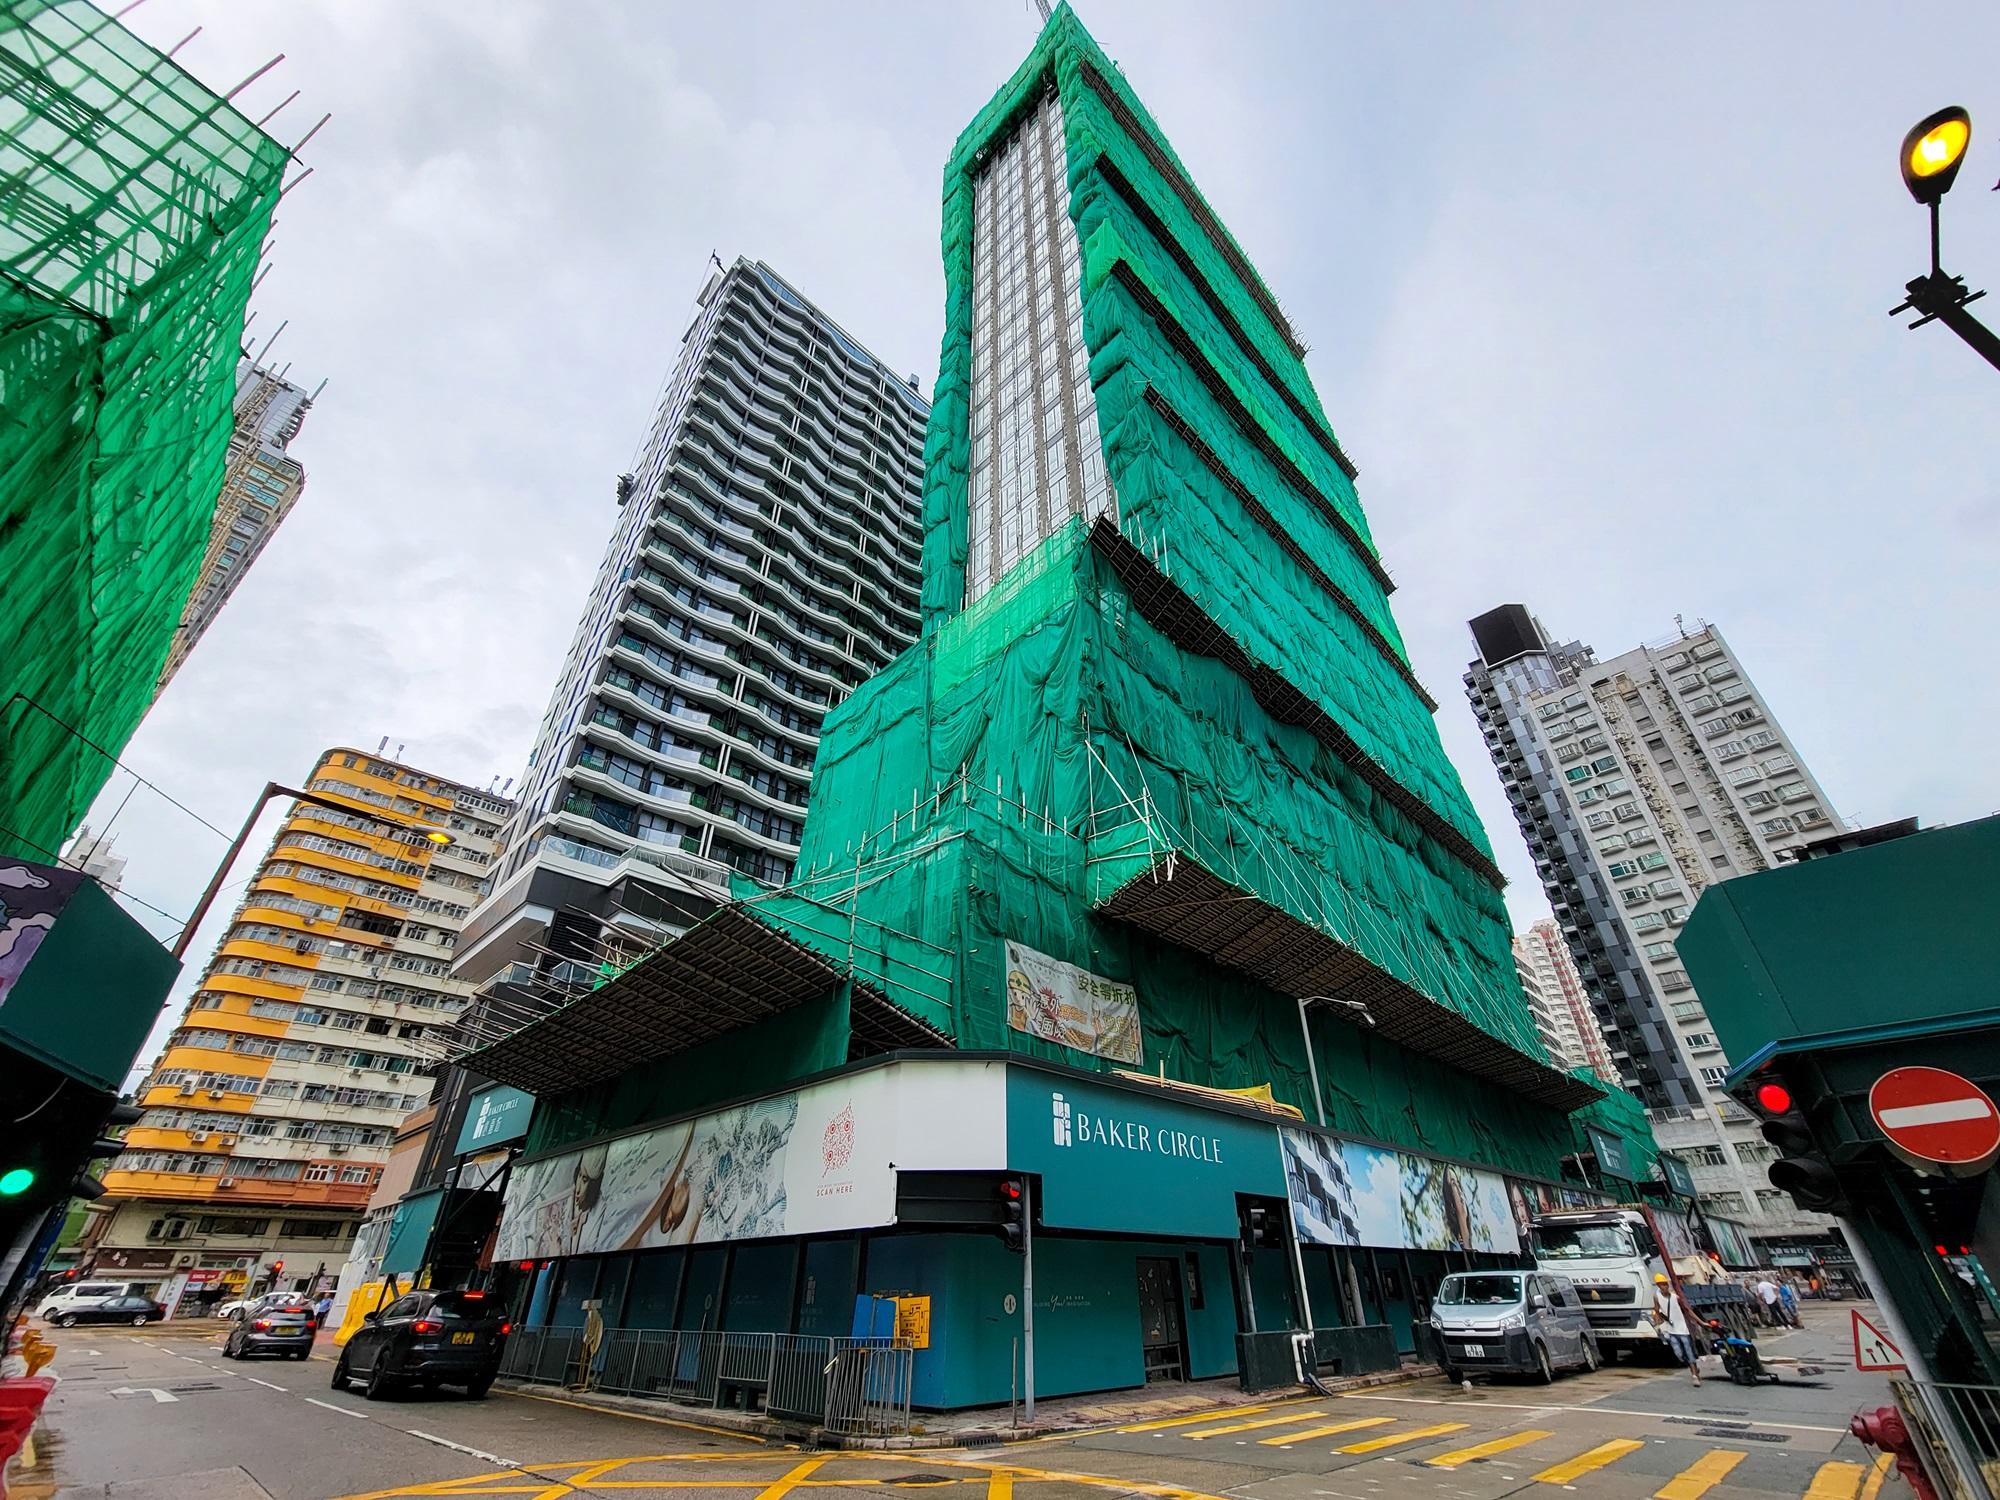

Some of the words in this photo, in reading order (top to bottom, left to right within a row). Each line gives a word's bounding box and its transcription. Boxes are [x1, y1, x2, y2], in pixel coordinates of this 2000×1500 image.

[1077, 974, 1135, 1006] 安全零折扣
[1078, 1113, 1152, 1152] BAKER
[1157, 1129, 1223, 1163] CIRCLE
[816, 1188, 833, 1197] SCAN
[836, 1185, 853, 1194] HERE
